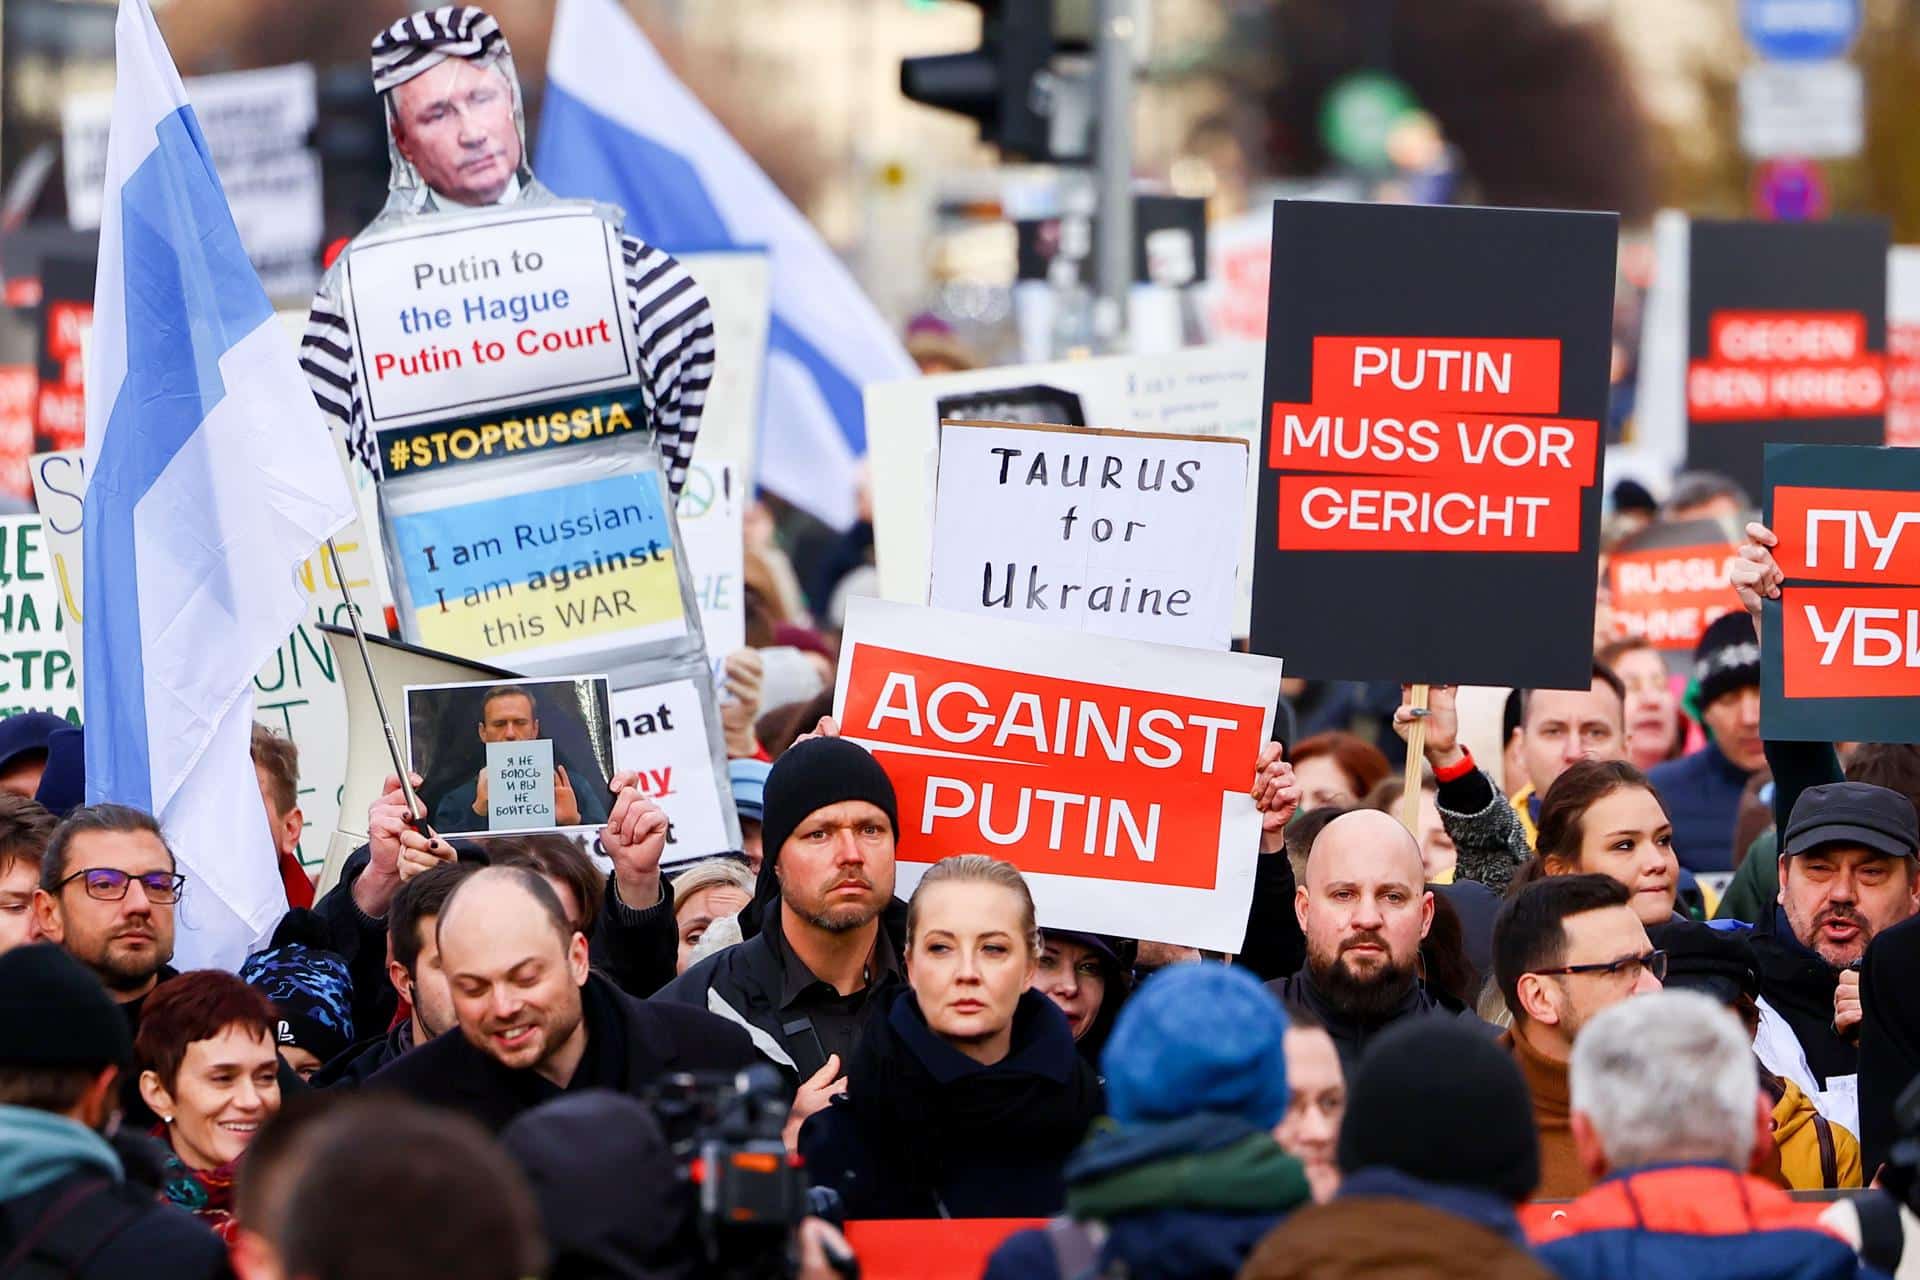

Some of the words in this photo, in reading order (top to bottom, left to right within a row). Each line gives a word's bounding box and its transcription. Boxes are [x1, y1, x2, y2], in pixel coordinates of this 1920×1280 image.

[414, 256, 500, 291] Putin
[511, 249, 544, 274] to
[400, 307, 452, 335] the
[463, 288, 570, 323] Hague
[375, 345, 463, 381] Putin
[472, 340, 506, 364] to
[516, 318, 612, 356] Court
[1352, 345, 1512, 394] PUTIN
[390, 403, 632, 471] #STOPRUSSIA
[1281, 414, 1441, 464] MUSS
[1456, 422, 1576, 469] VOR
[991, 447, 1201, 493] TAURUS
[422, 546, 440, 573] I
[452, 537, 503, 567] am
[514, 503, 654, 550] Russian.
[1060, 504, 1147, 543] for
[1300, 486, 1551, 538] GERICHT
[434, 587, 450, 614] I
[463, 577, 514, 608] am
[527, 539, 666, 592] against
[982, 561, 1192, 617] Ukraine
[483, 615, 546, 648] this
[555, 589, 637, 628] WAR
[866, 671, 1239, 775] AGAINST
[501, 768, 541, 779] БОЮСЬ
[506, 781, 516, 791] И
[520, 780, 536, 791] ВЫ
[507, 756, 514, 767] Я
[519, 755, 534, 766] НЕ
[514, 792, 529, 803] НЕ
[920, 775, 1161, 863] PUTIN
